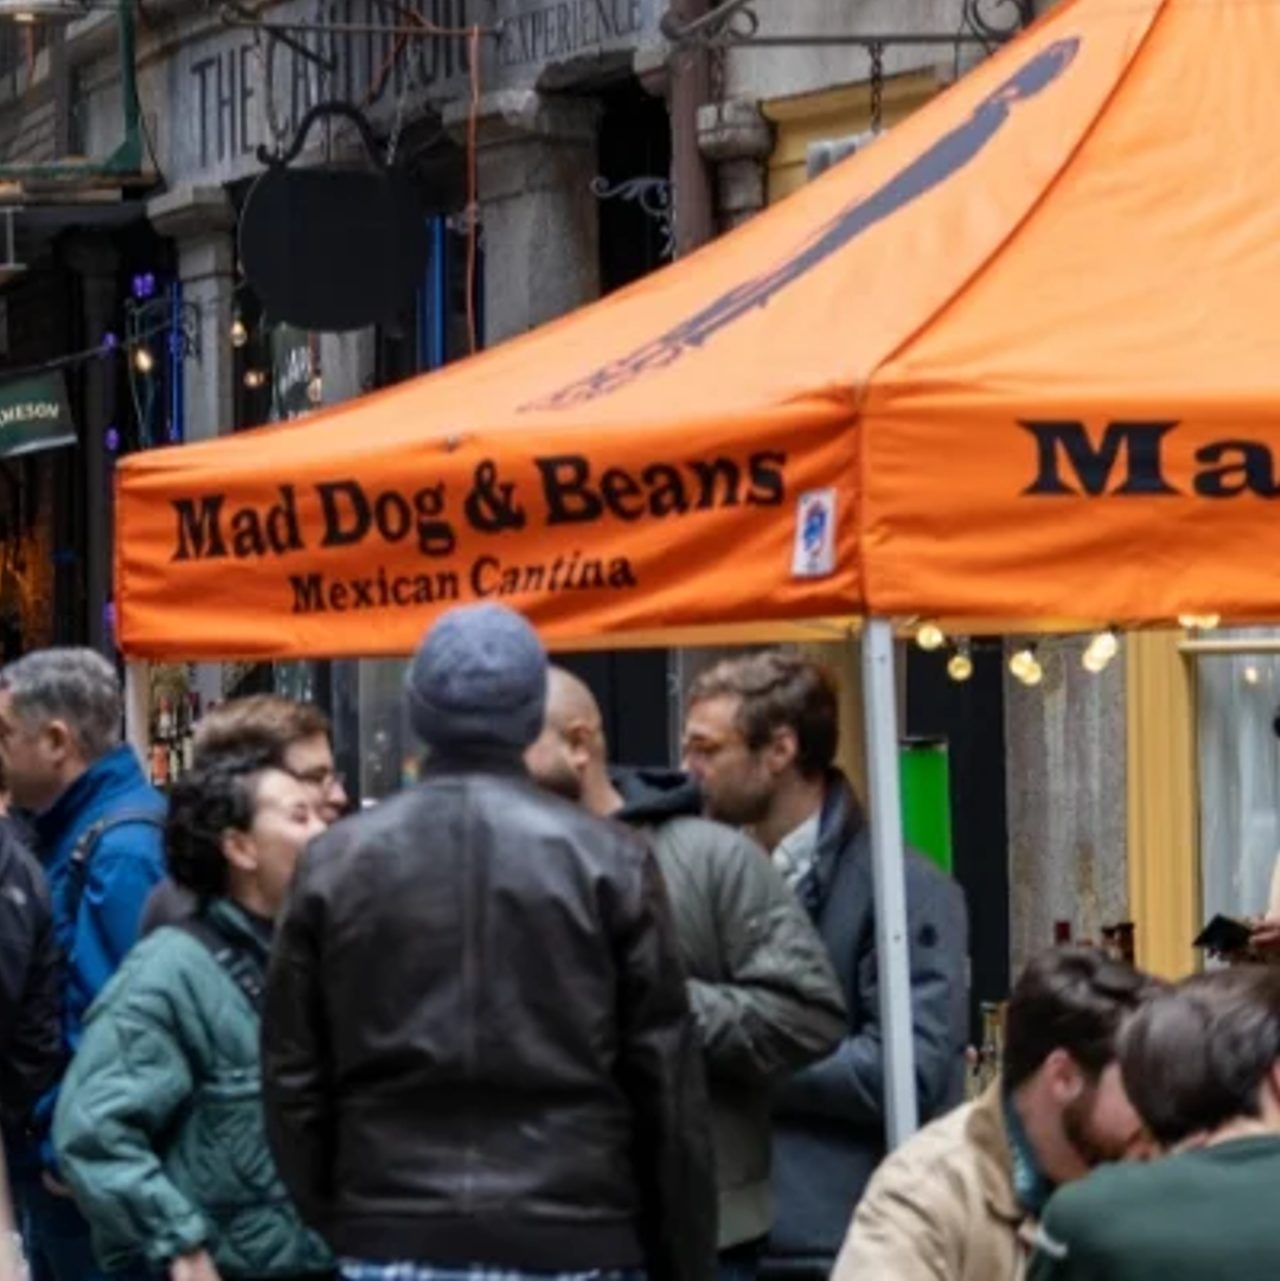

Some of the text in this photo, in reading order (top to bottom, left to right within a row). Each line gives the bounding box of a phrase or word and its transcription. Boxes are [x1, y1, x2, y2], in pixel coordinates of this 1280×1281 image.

[190, 42, 254, 168] THE
[170, 451, 788, 562] Mad Dog & Beans
[288, 550, 637, 615] Mexican Cantina
